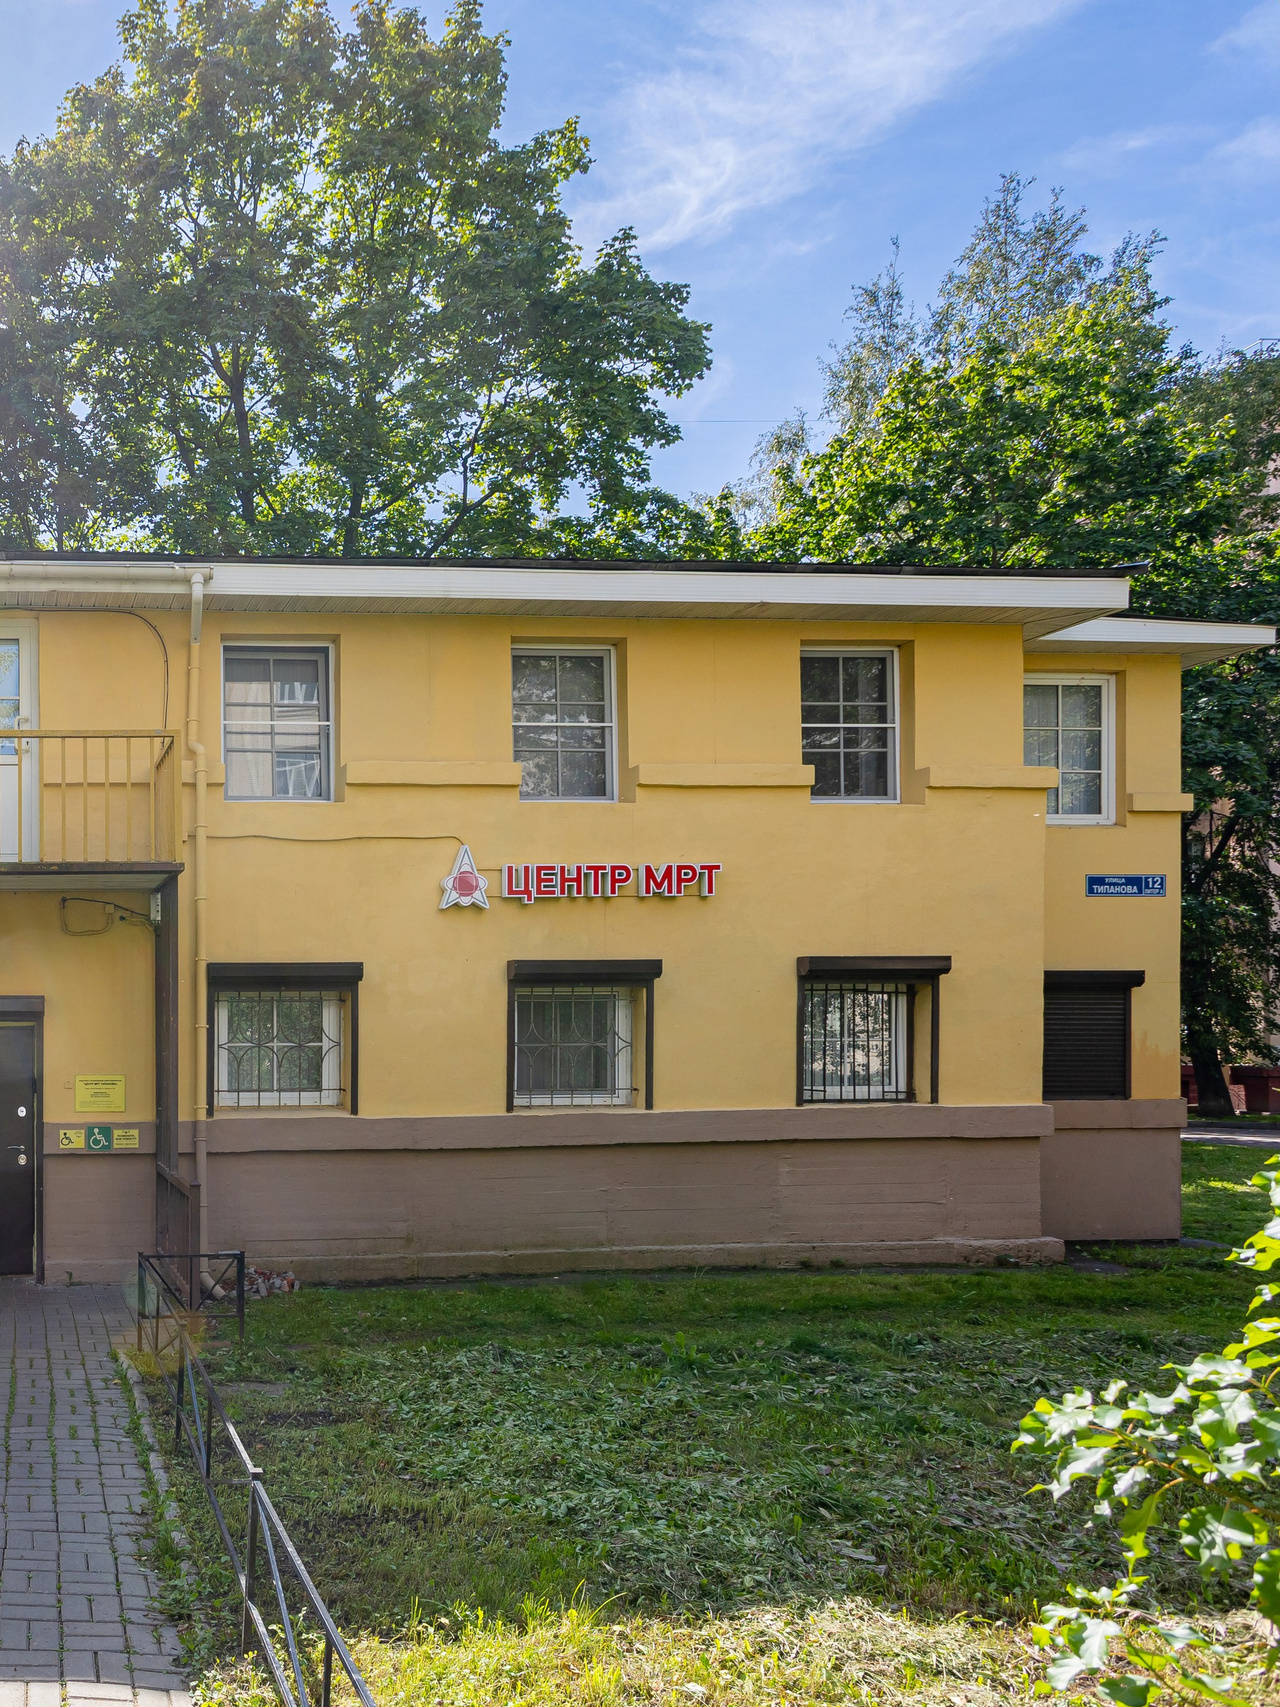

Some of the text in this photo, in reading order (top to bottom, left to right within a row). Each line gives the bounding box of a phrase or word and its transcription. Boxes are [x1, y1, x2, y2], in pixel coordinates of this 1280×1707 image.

[503, 863, 722, 904] ЦЕНТР МРТ
[1147, 877, 1161, 888] 12
[1092, 885, 1138, 893] ТИПАНОВА
